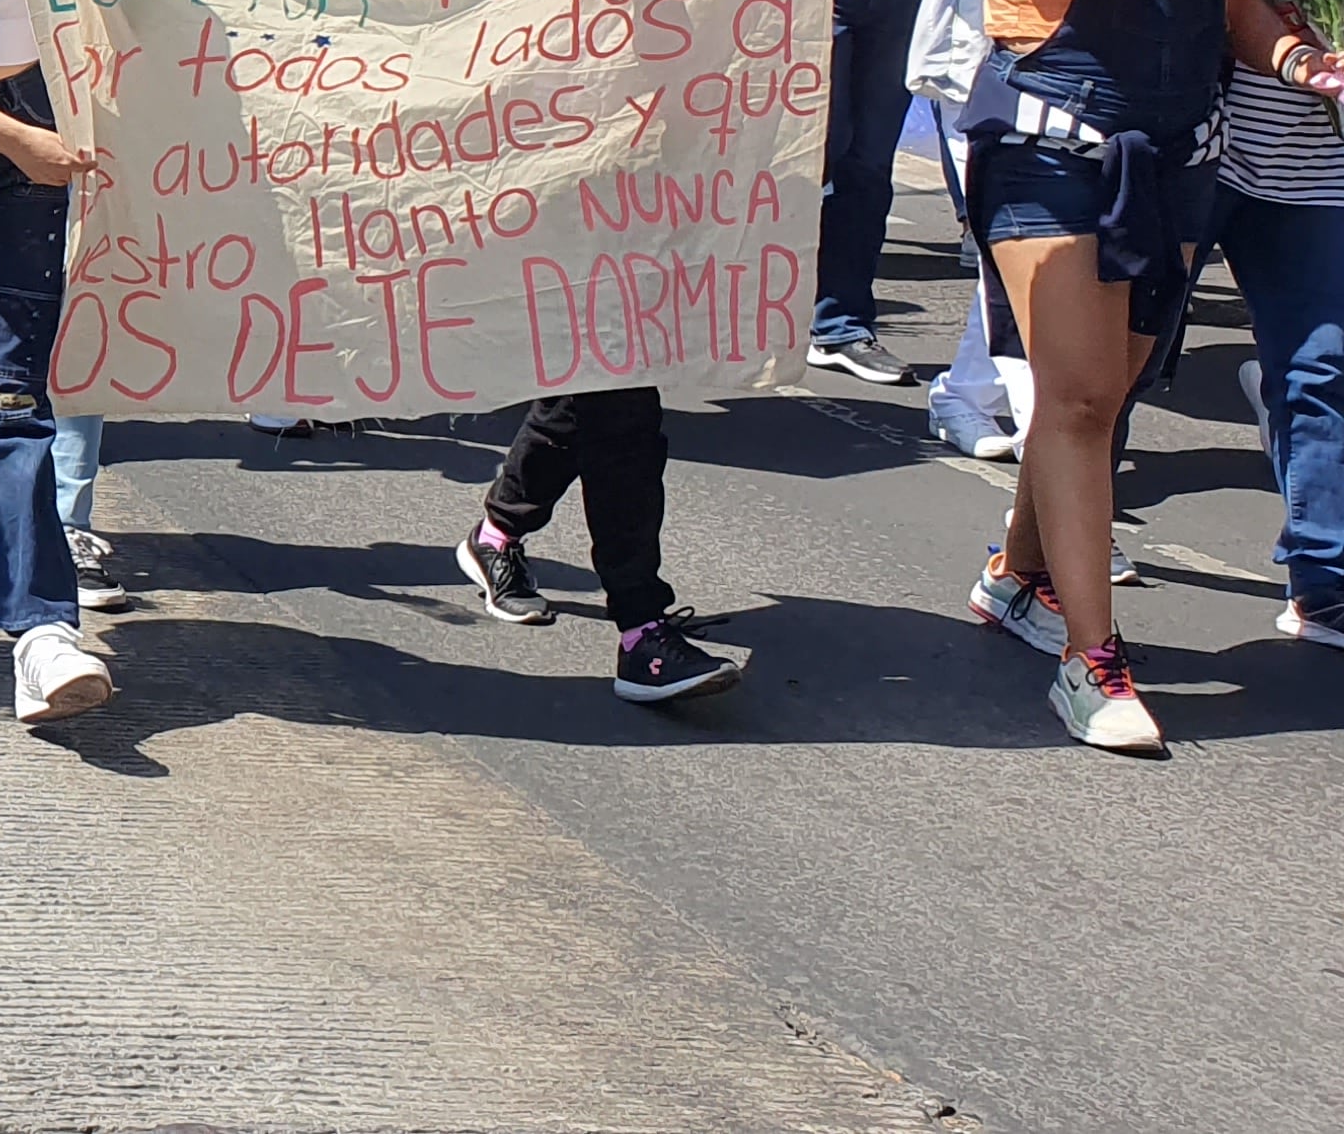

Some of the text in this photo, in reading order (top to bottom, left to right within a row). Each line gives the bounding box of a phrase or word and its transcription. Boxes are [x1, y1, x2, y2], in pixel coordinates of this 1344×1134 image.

[177, 16, 411, 98] todos
[152, 84, 595, 196] autoridades
[625, 85, 666, 149] y
[683, 62, 821, 156] que
[310, 187, 538, 271] llanto
[578, 169, 781, 233] NUNCA
[227, 257, 476, 403] DEJE
[522, 243, 799, 387] DORMIR
